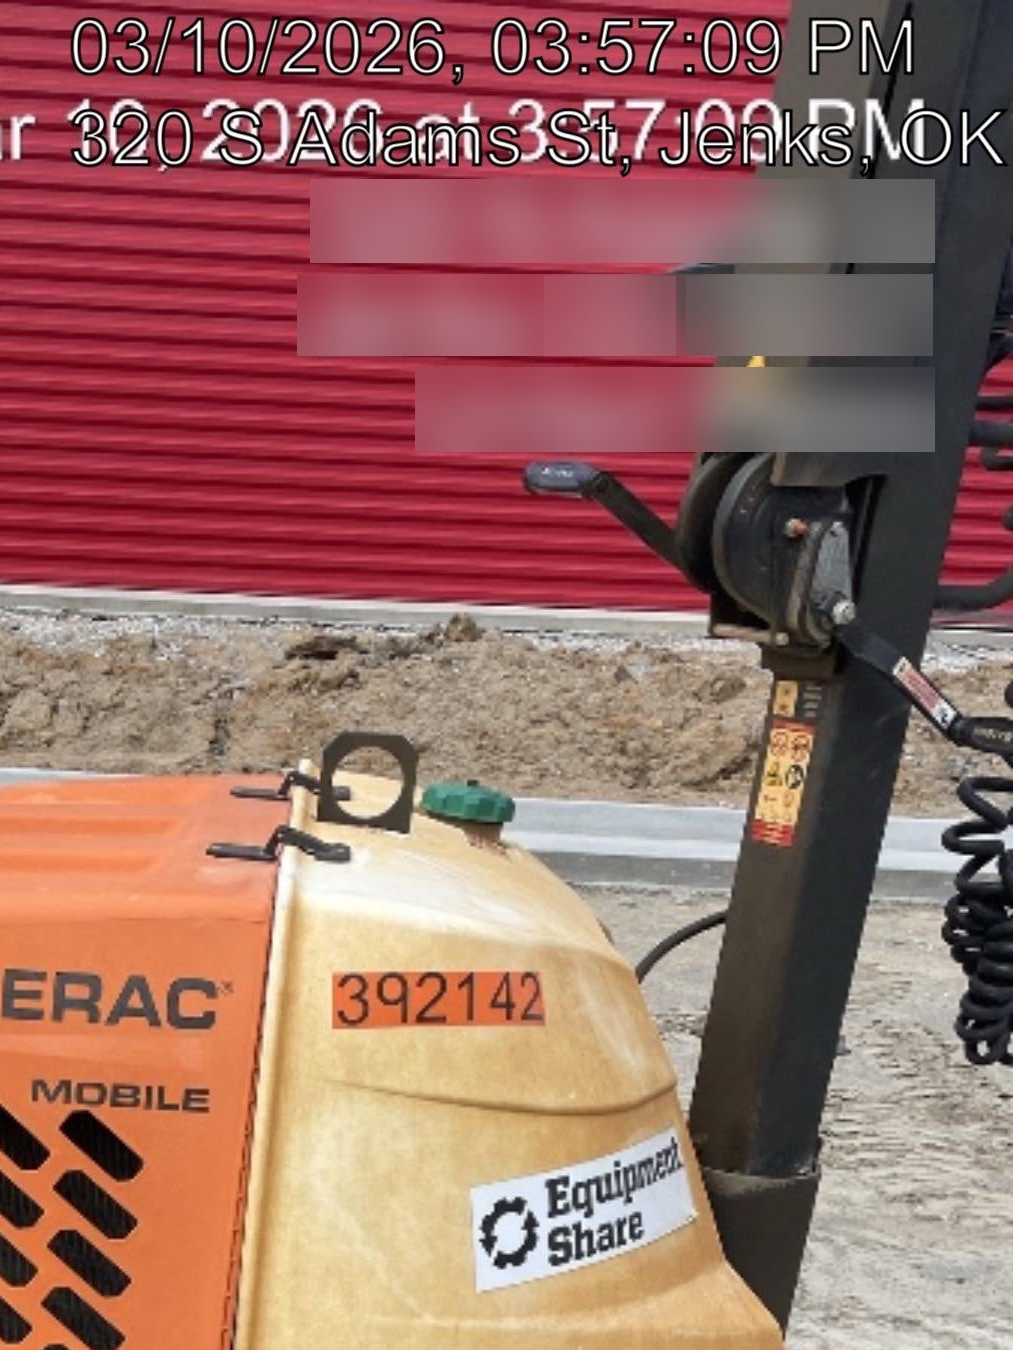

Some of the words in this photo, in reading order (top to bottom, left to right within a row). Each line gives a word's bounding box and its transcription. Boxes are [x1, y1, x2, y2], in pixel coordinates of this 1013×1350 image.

[337, 971, 544, 1026] 392142
[31, 1079, 210, 1113] MOBILE
[545, 1136, 685, 1218] Equipment
[547, 1211, 645, 1266] Share
